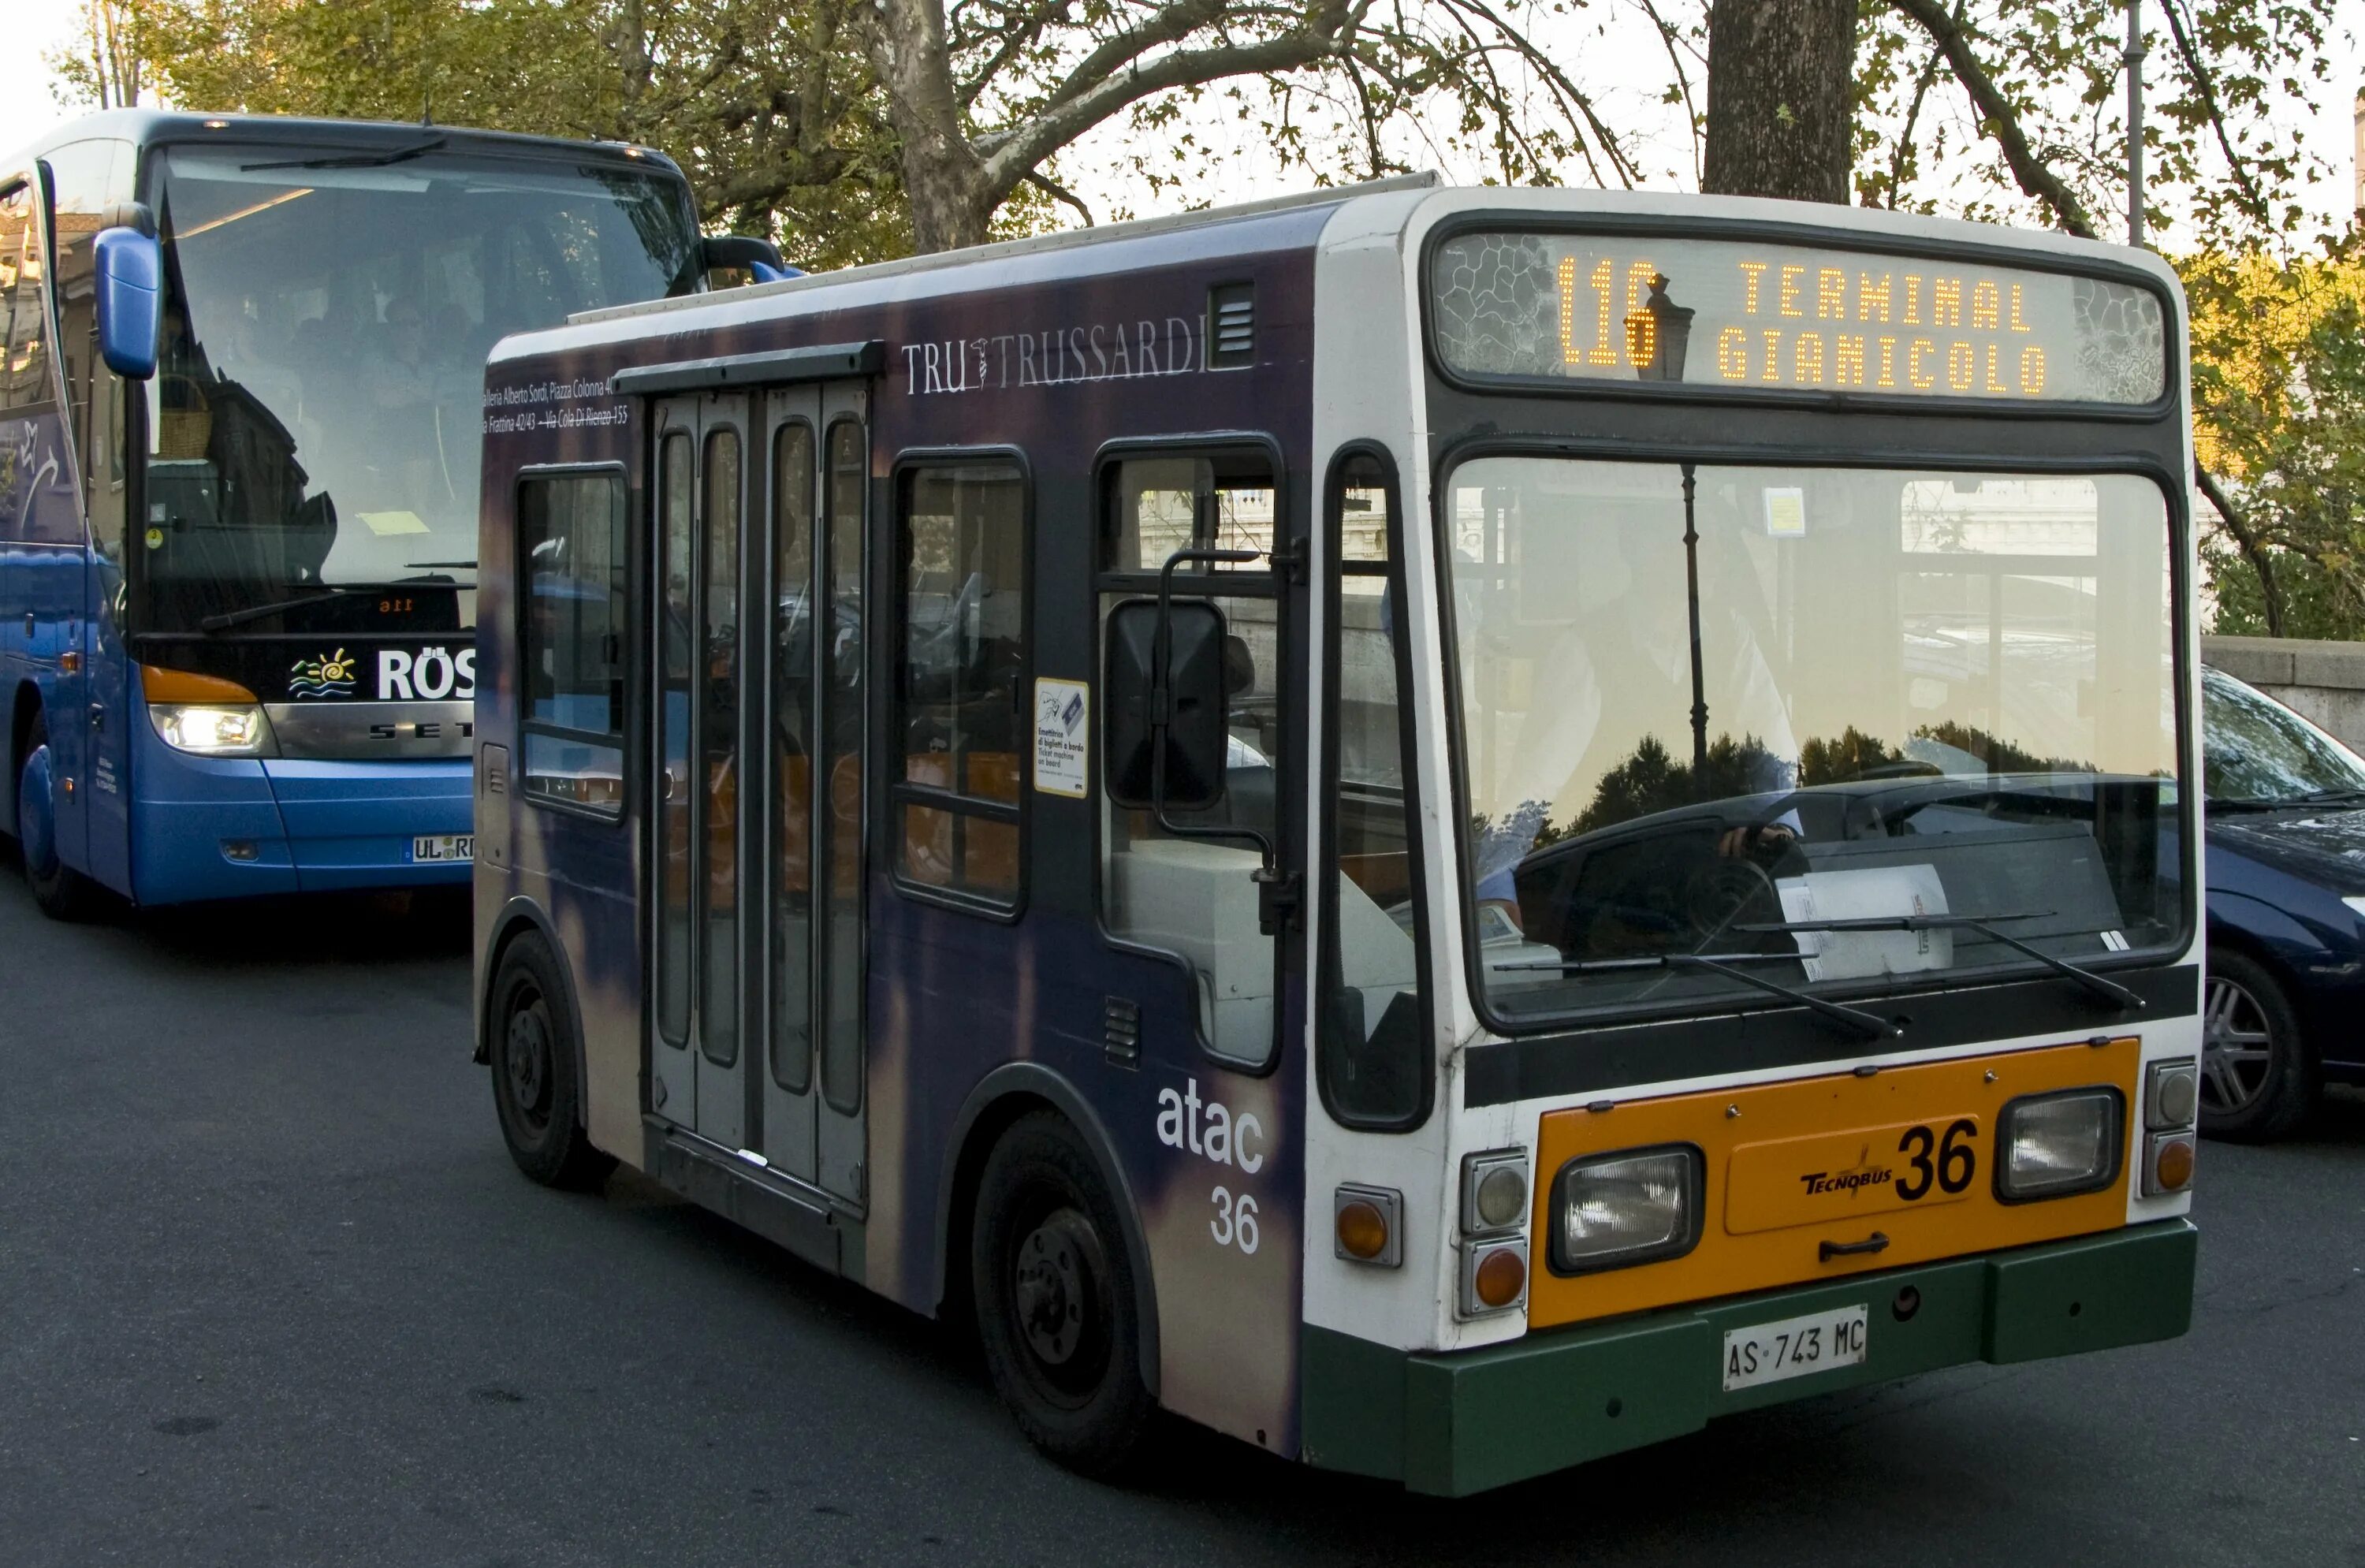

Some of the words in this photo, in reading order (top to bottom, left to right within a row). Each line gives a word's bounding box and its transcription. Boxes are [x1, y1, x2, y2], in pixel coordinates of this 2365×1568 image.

[1740, 262, 2032, 332] TERMINAL
[901, 340, 966, 394] TRU
[992, 315, 1208, 389] TRUSSARDI
[1717, 327, 2045, 394] GIANICOLO
[504, 386, 528, 404] Alberto
[550, 382, 572, 400] Piazza
[573, 378, 604, 398] Colonna
[489, 415, 514, 433] Frattina
[516, 412, 535, 431] 42/43
[546, 411, 557, 429] Via
[558, 408, 575, 428] Cola
[576, 408, 585, 426] Di
[586, 407, 611, 426] Rienzo
[614, 405, 628, 425] 155
[378, 646, 476, 699] RÖS
[1038, 737, 1043, 746] di
[1045, 738, 1063, 749] biglietti
[1038, 747, 1052, 758] Ticket
[1054, 750, 1074, 761] machine
[1046, 758, 1060, 768] board
[415, 839, 441, 858] UL
[1156, 1078, 1263, 1174] atac
[1801, 1169, 1892, 1195] TECNOBUS
[1895, 1119, 1978, 1201] 36
[1211, 1186, 1259, 1254] 36
[1728, 1341, 1758, 1377] AS
[1775, 1327, 1821, 1369] 743
[1834, 1319, 1864, 1356] MC
